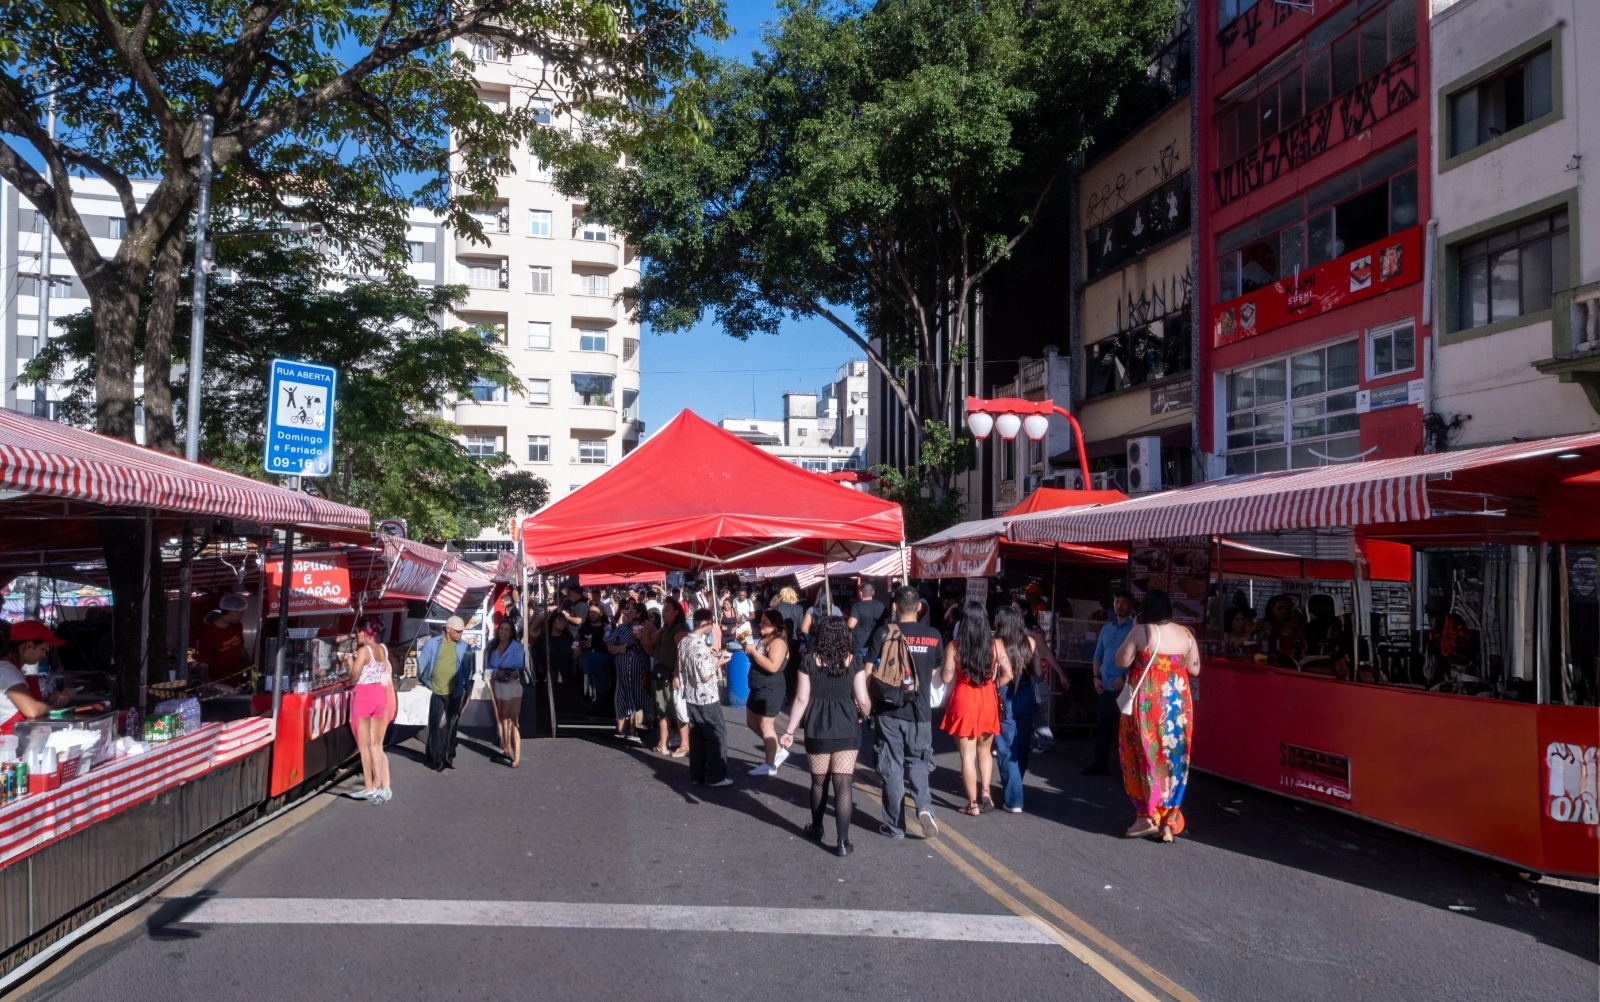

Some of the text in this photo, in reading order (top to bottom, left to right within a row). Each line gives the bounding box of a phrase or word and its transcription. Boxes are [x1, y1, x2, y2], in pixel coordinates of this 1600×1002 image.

[1287, 290, 1312, 305] SUSHI
[277, 367, 331, 382] RUA ABERTA
[277, 431, 323, 445] Domingo
[284, 444, 323, 455] Feriado
[276, 556, 338, 573] TMPURÁ
[303, 574, 313, 585] E
[915, 636, 921, 645] A
